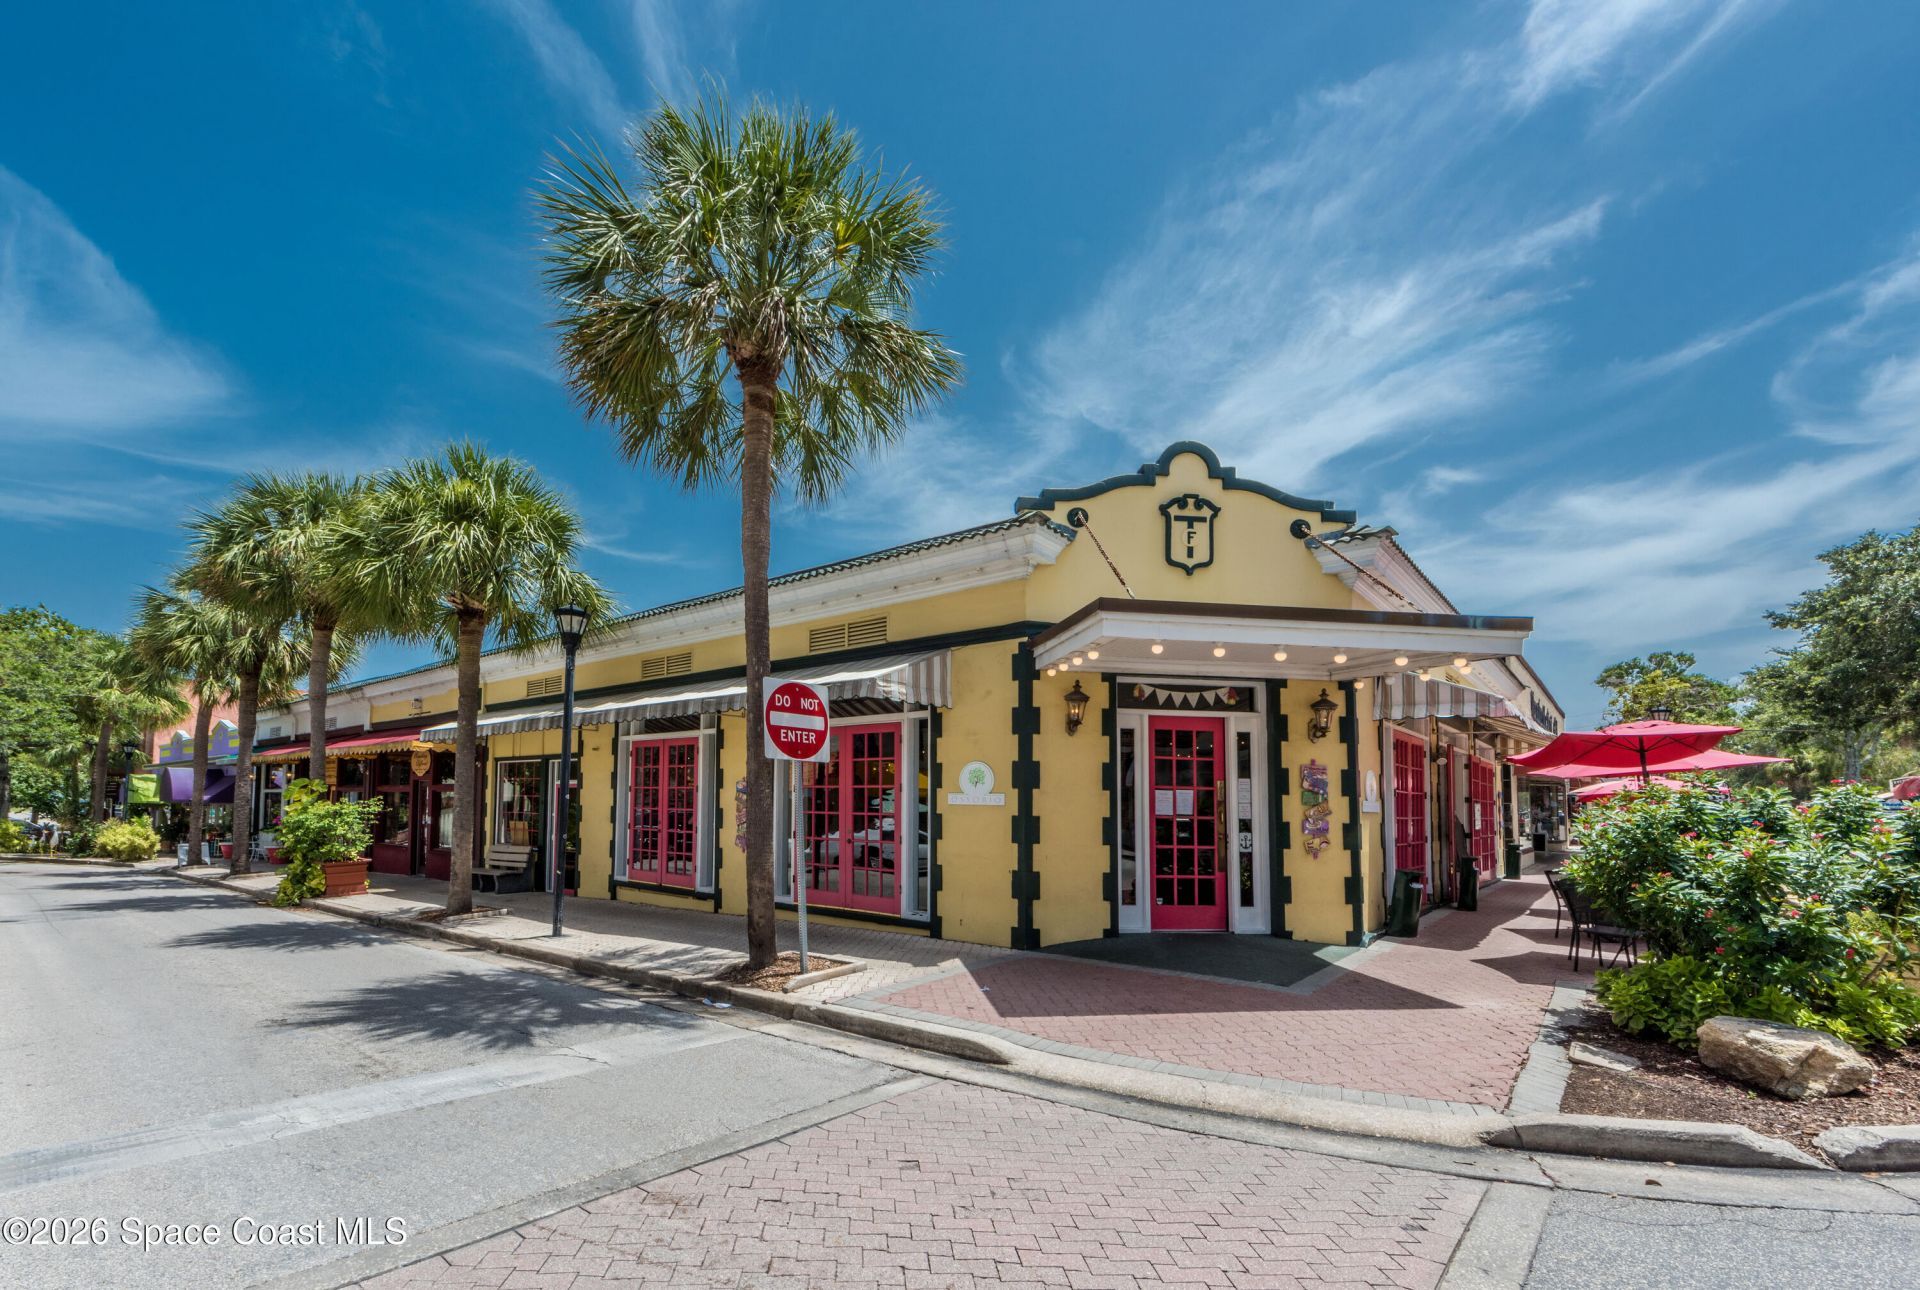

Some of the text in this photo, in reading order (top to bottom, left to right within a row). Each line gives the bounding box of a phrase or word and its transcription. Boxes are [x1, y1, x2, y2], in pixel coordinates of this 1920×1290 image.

[775, 694, 819, 711] DO NOT
[780, 729, 816, 744] ENTER
